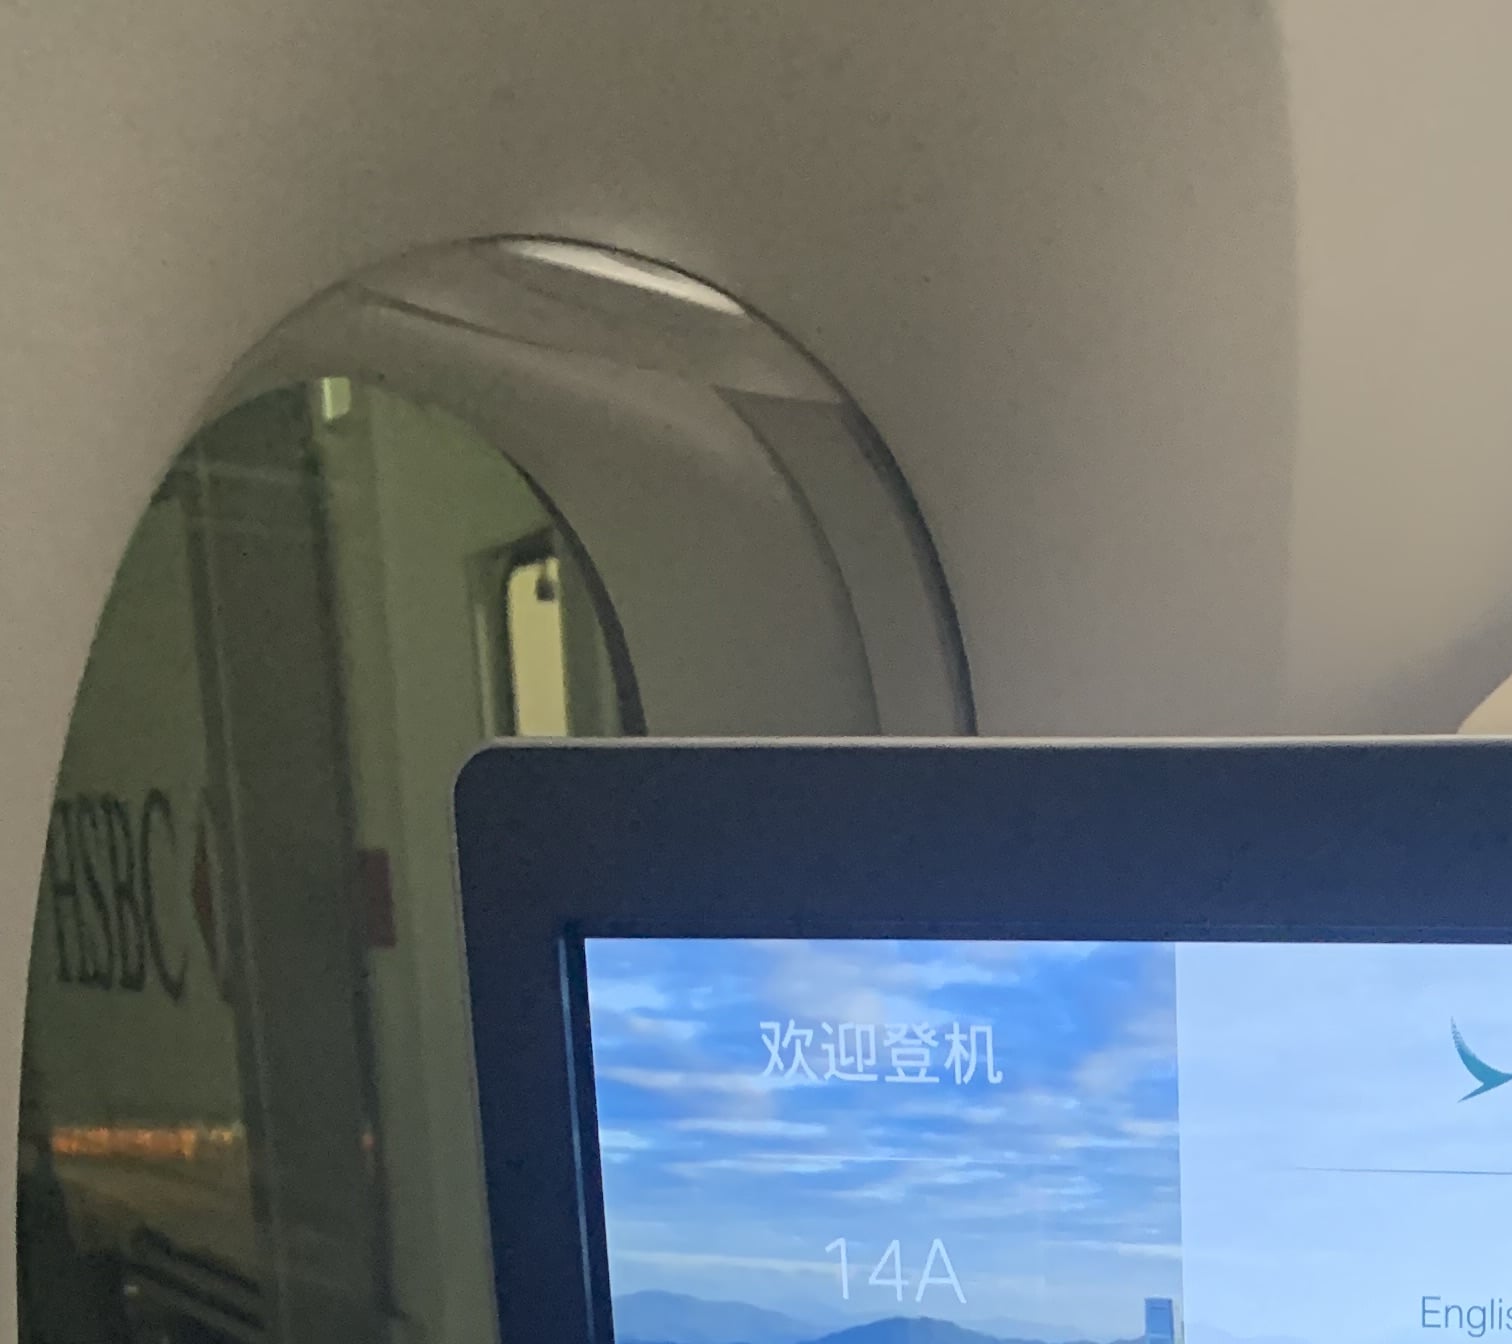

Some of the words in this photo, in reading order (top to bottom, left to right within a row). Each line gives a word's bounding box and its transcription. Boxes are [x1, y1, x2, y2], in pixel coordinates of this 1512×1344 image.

[49, 788, 189, 1003] HSBC
[759, 1018, 1003, 1087] 欢迎登机
[824, 1236, 968, 1305] 14A
